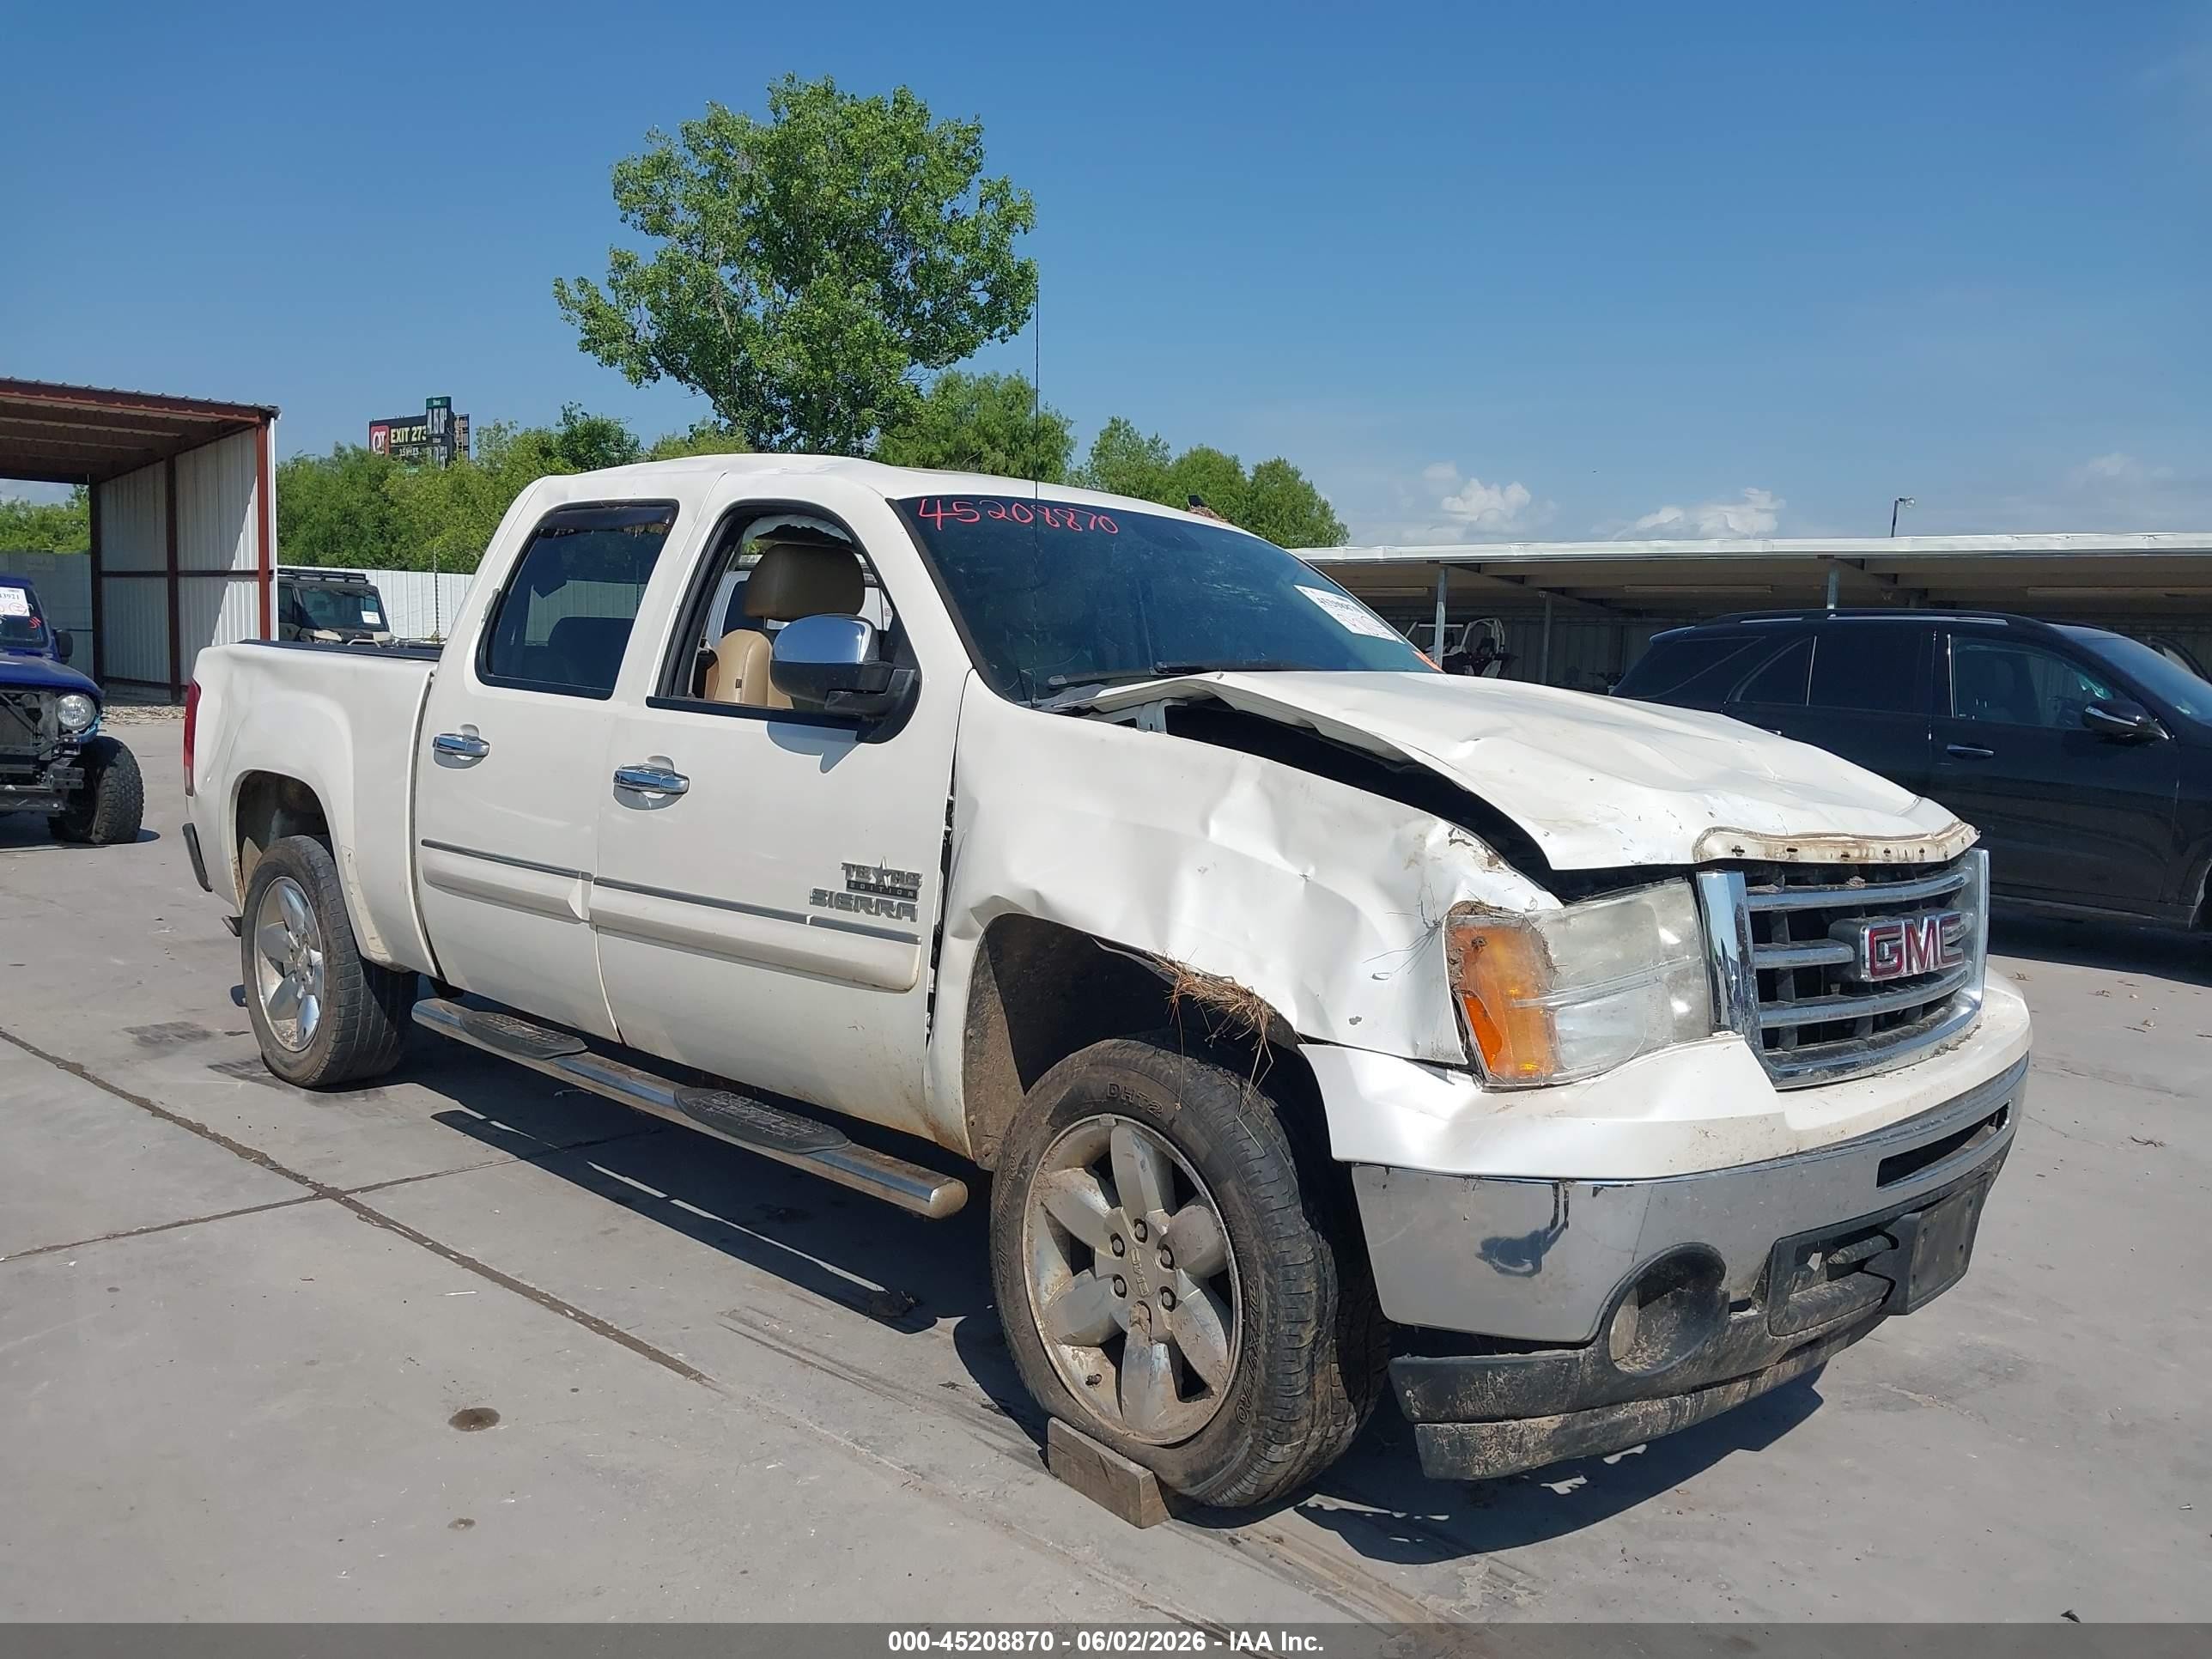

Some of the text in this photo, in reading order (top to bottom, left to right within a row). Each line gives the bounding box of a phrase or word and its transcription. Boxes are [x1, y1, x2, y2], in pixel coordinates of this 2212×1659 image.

[373, 431, 386, 454] QT
[391, 428, 410, 443] EXIT
[411, 426, 427, 441] 273
[919, 498, 1119, 534] 45208870
[810, 888, 918, 922] SIERRA
[848, 882, 915, 897] EDITION
[1861, 911, 1964, 981] GMC
[1106, 1081, 1164, 1119] DHT2
